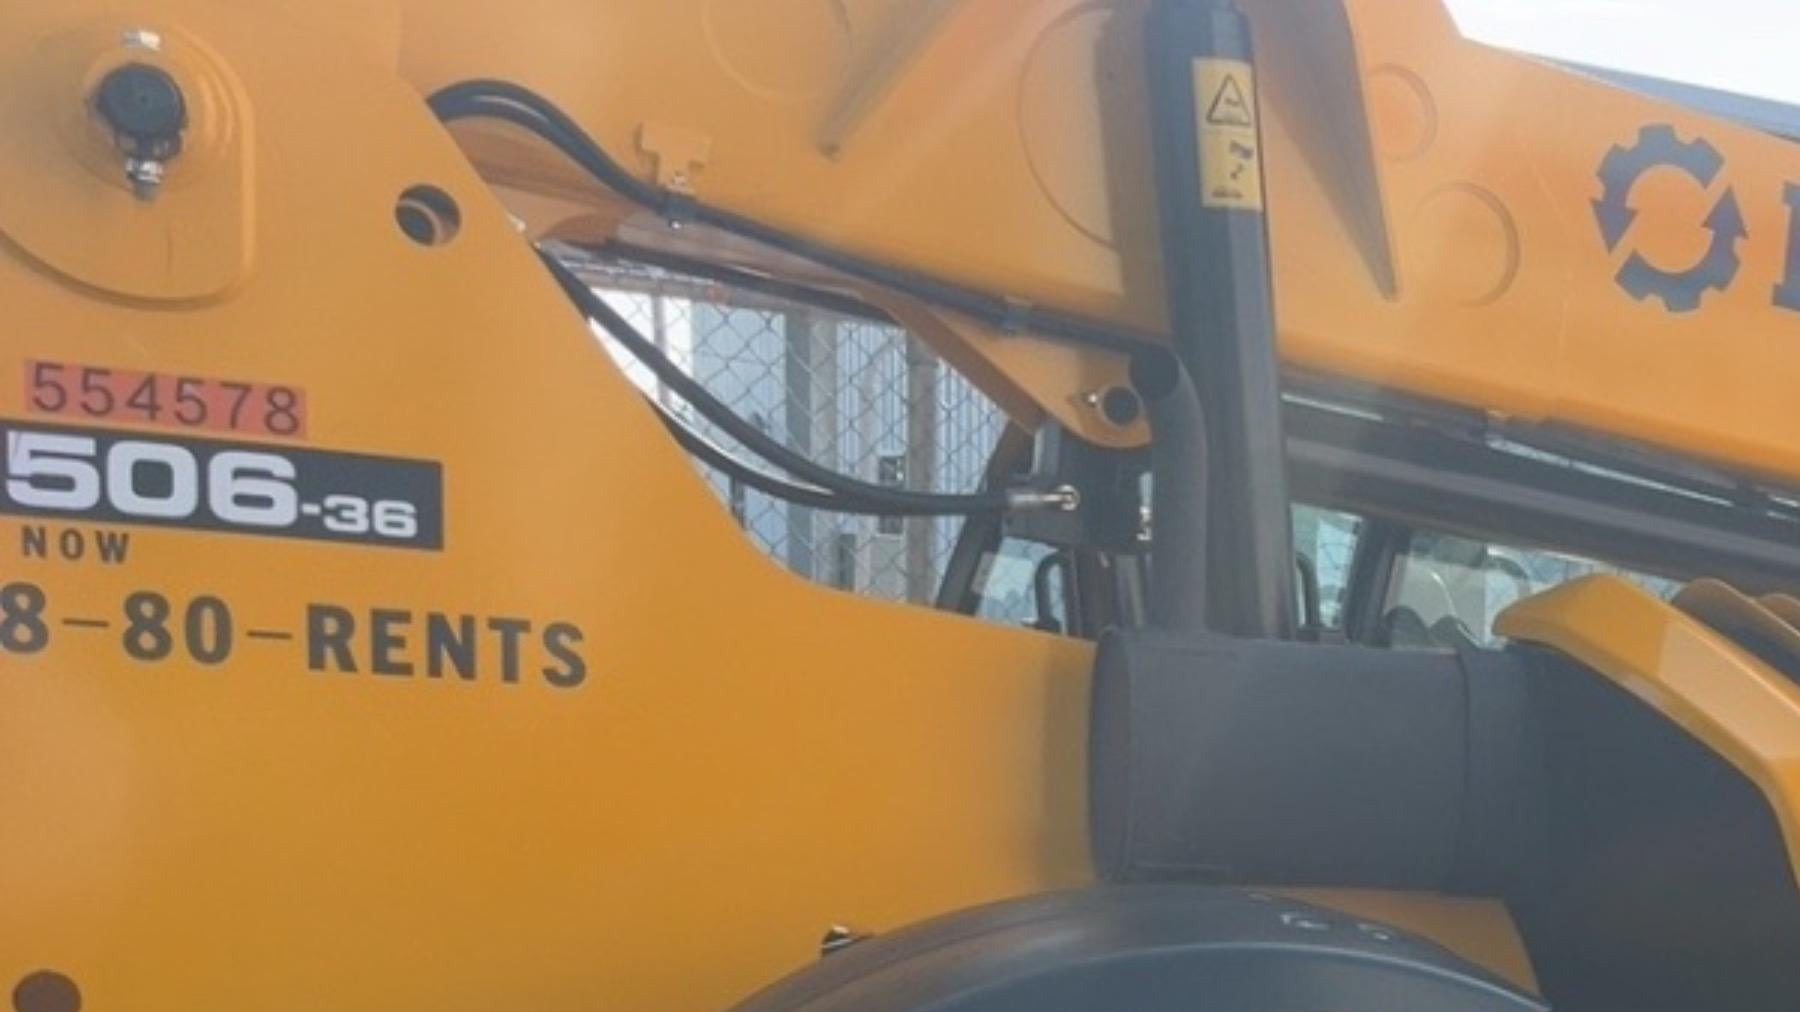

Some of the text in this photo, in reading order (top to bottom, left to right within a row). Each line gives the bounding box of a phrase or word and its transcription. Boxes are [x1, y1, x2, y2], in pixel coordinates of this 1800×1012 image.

[31, 360, 300, 437] 554578
[5, 429, 418, 539] 506-36
[21, 526, 130, 566] NOW
